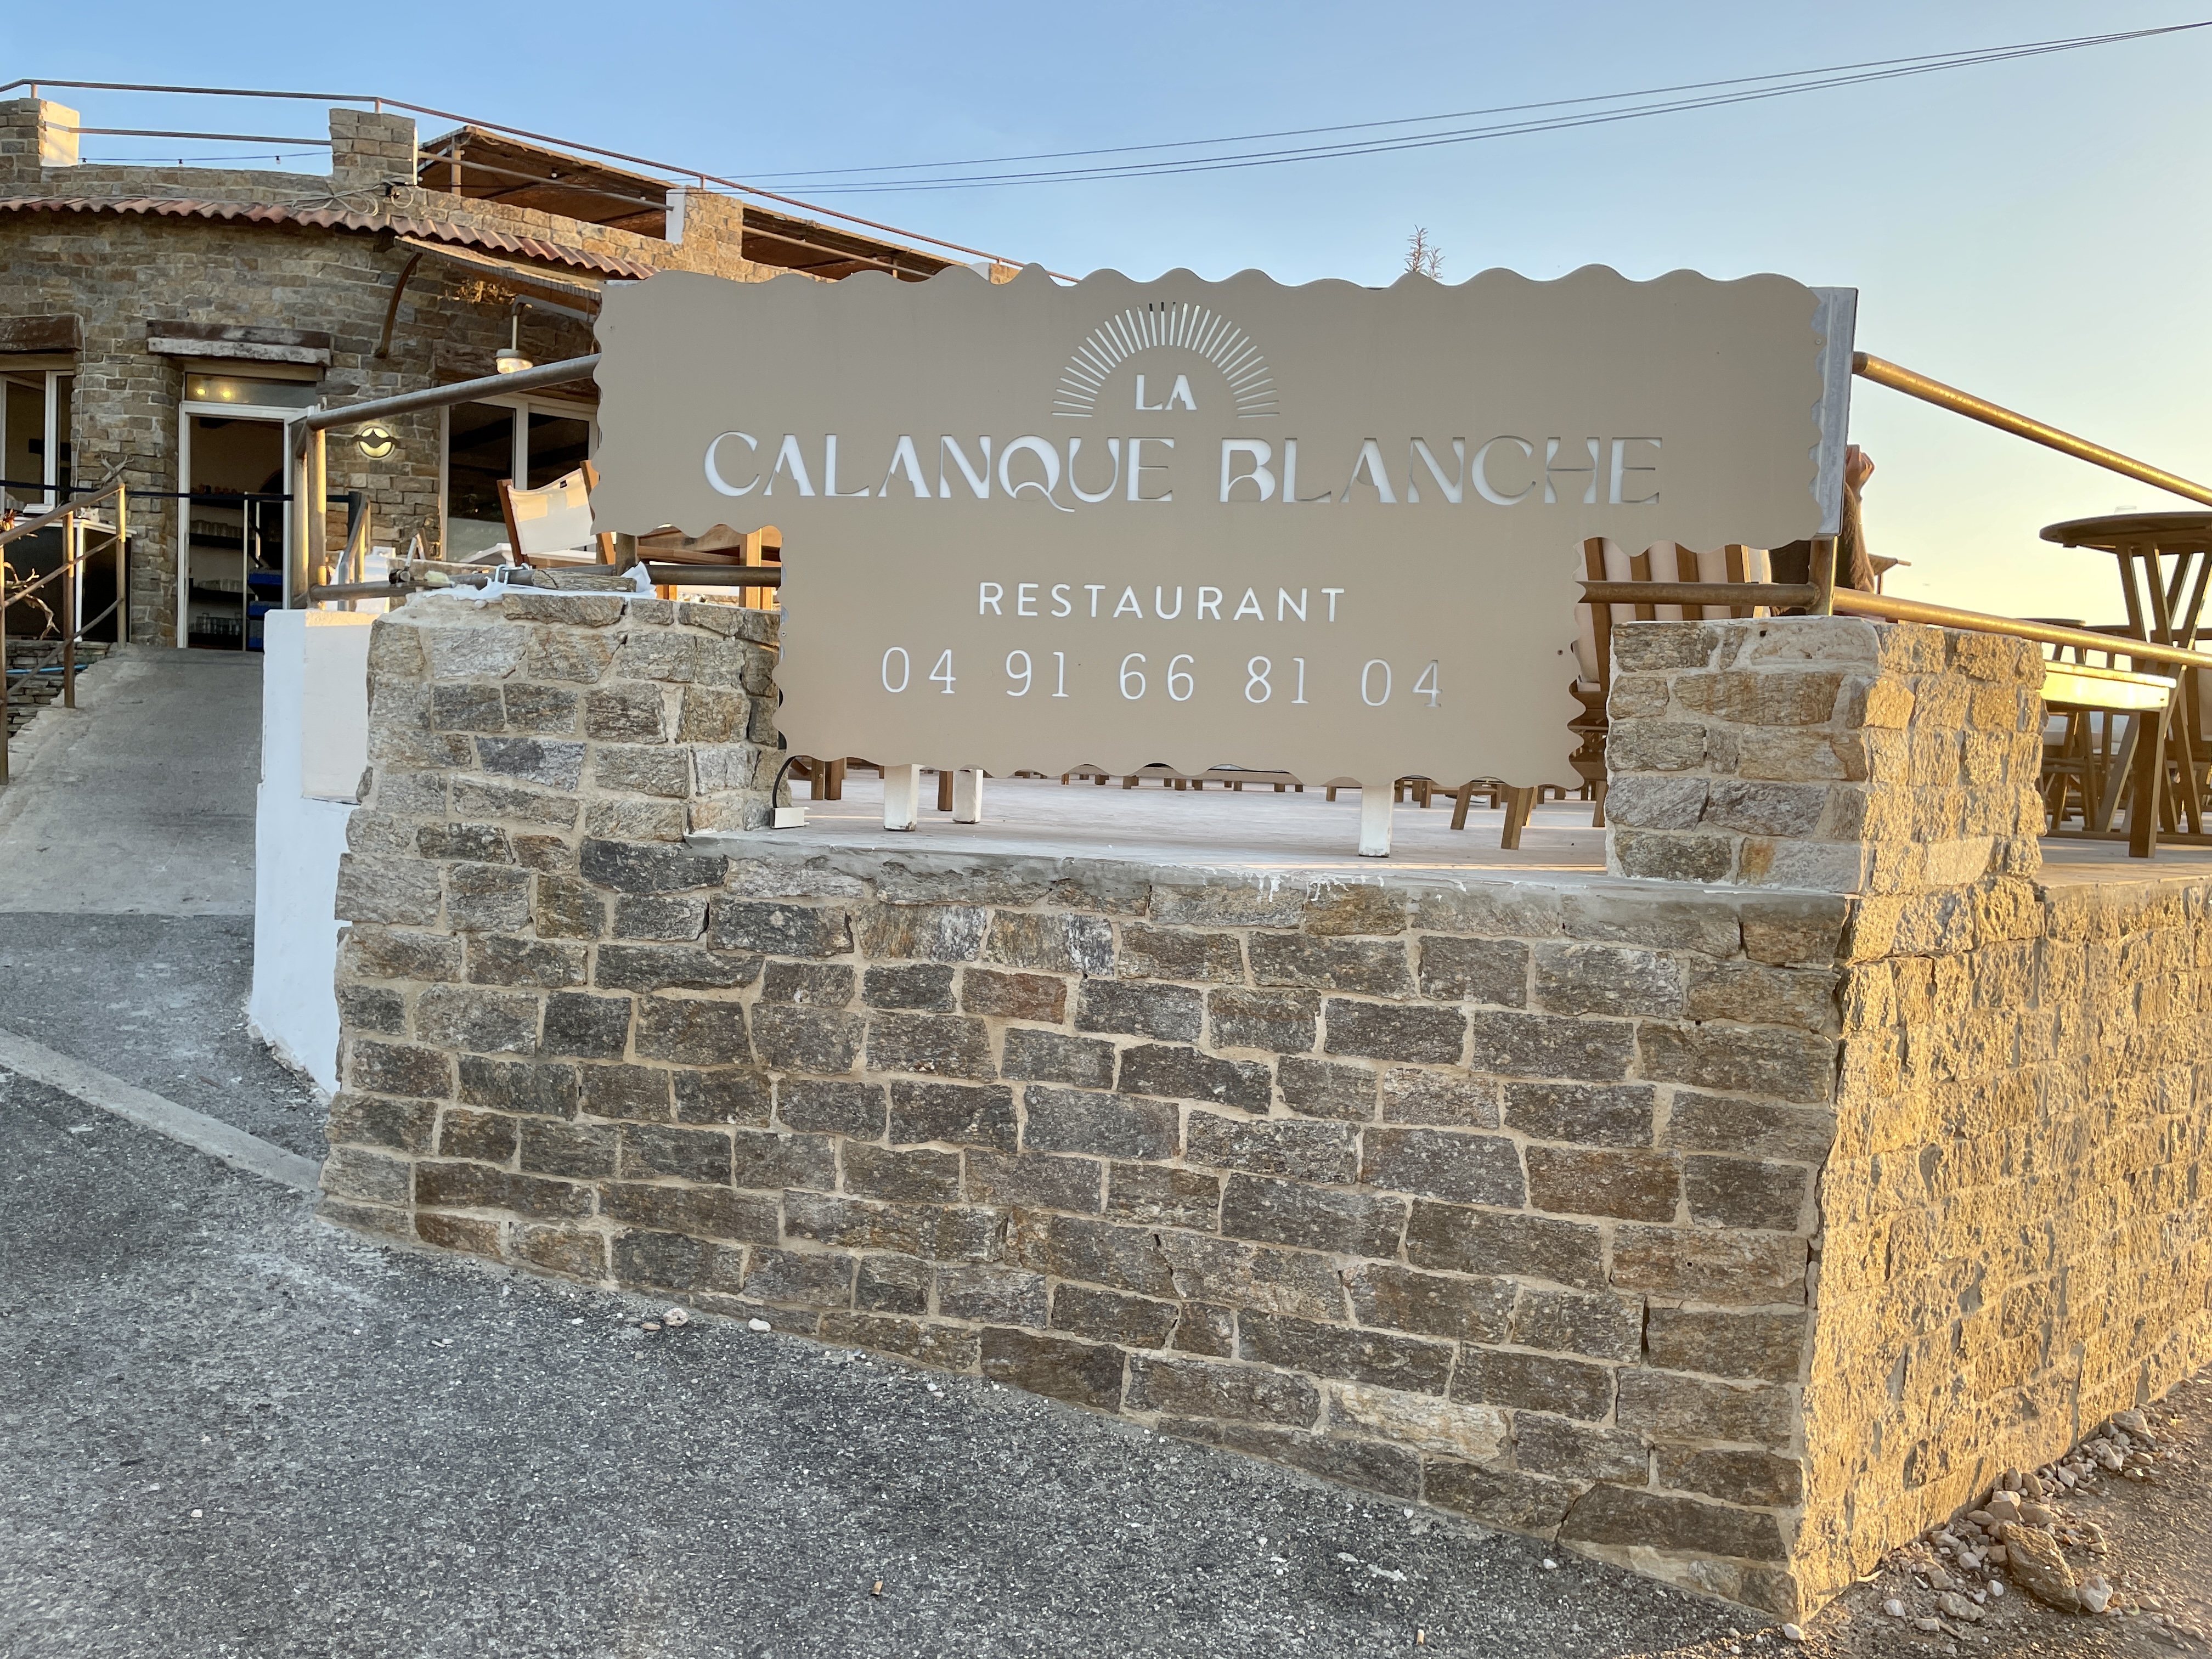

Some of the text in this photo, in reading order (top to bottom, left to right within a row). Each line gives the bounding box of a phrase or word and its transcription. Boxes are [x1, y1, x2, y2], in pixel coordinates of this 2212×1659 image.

[1135, 374, 1198, 411] LA
[704, 431, 1663, 512] CALANQUE BLANCHE
[978, 582, 1345, 622] RESTAURANT
[881, 646, 1443, 708] 04 91 66 81 04
